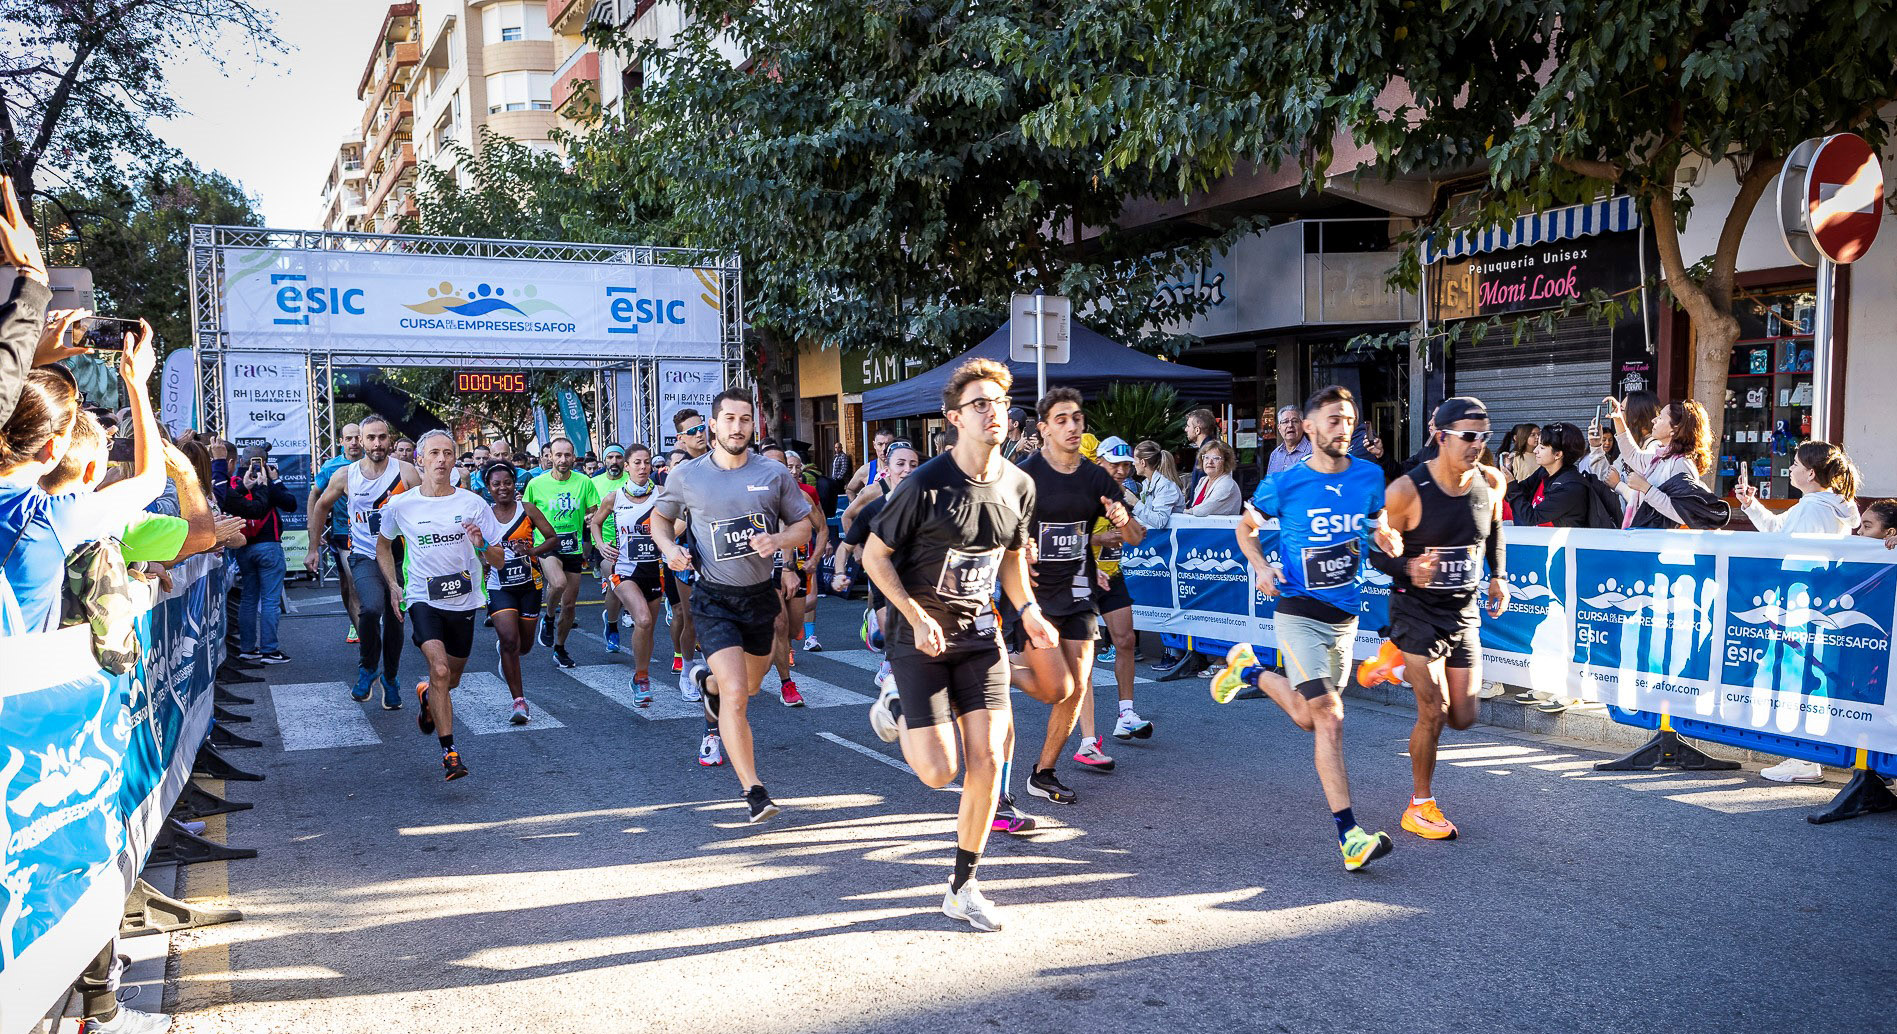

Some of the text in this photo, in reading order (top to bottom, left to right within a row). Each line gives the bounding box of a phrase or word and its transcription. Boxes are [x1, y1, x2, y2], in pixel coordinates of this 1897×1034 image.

[1468, 249, 1588, 274] Peluquería Unisex
[1478, 265, 1581, 307] Moni Look
[400, 318, 445, 329] CURSA
[457, 320, 524, 332] EMPRESES
[534, 322, 576, 332] SAFOR
[234, 364, 278, 378] raes
[666, 370, 701, 384] raes
[460, 374, 524, 391] 00:04:05
[166, 367, 180, 414] Safor
[234, 390, 301, 398] RH BAYREN
[565, 392, 580, 421] teika
[249, 410, 286, 421] teika
[620, 524, 650, 534] ALPE
[724, 528, 756, 544] 1042
[638, 544, 655, 552] 316
[506, 566, 522, 575] 777
[1318, 556, 1352, 572] 1062
[1229, 574, 1248, 582] SAFOR
[440, 580, 462, 592] 289
[1183, 613, 1247, 627] cursaempresessafor.com
[1578, 610, 1608, 623] CURSA
[1727, 626, 1764, 639] CURSA
[1776, 630, 1836, 646] EMPRESES
[1845, 637, 1888, 651] SAFOR
